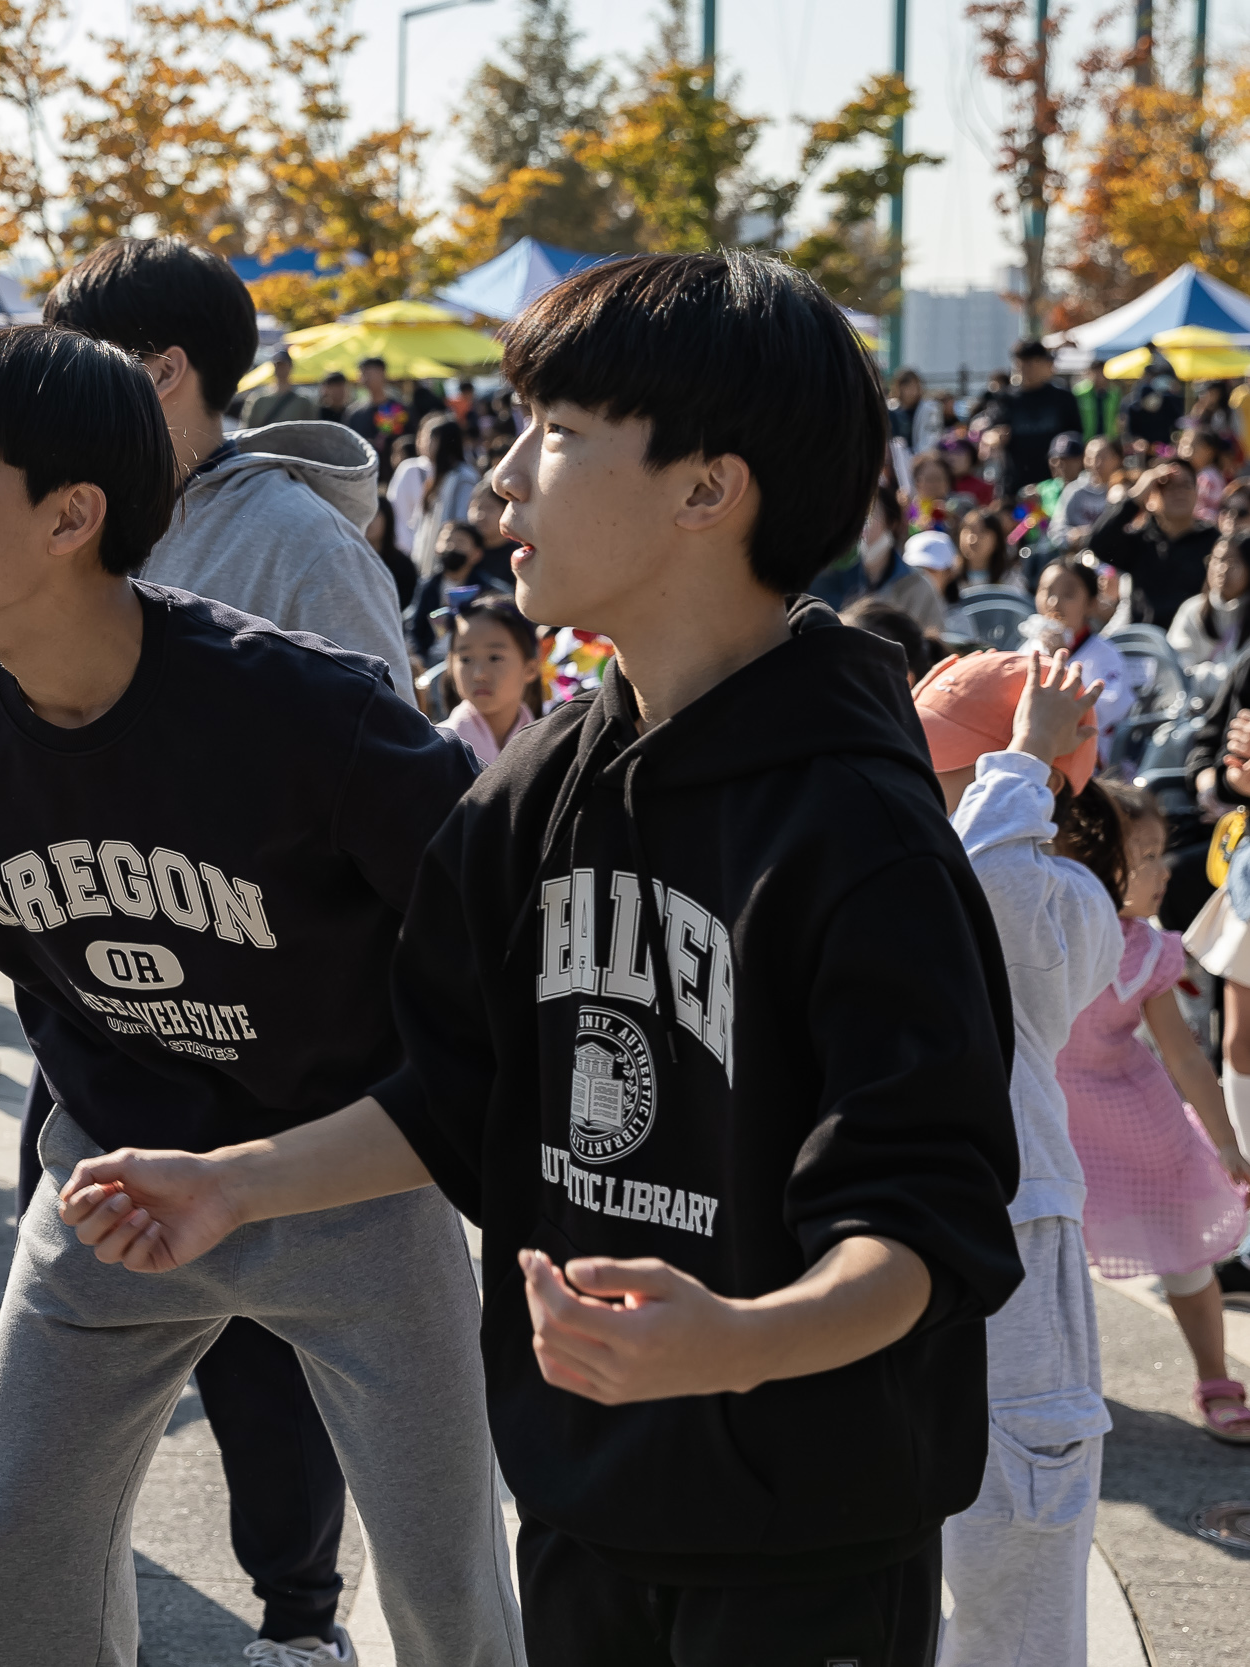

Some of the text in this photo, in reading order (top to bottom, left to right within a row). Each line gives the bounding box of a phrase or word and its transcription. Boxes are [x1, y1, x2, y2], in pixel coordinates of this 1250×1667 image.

[106, 948, 164, 984] OR
[182, 1000, 258, 1041] STATE
[169, 1040, 239, 1061] STATES
[617, 1026, 652, 1117] AUTHENTIC
[587, 1116, 646, 1155] LIBRARY
[603, 1176, 719, 1238] LIBRARY
